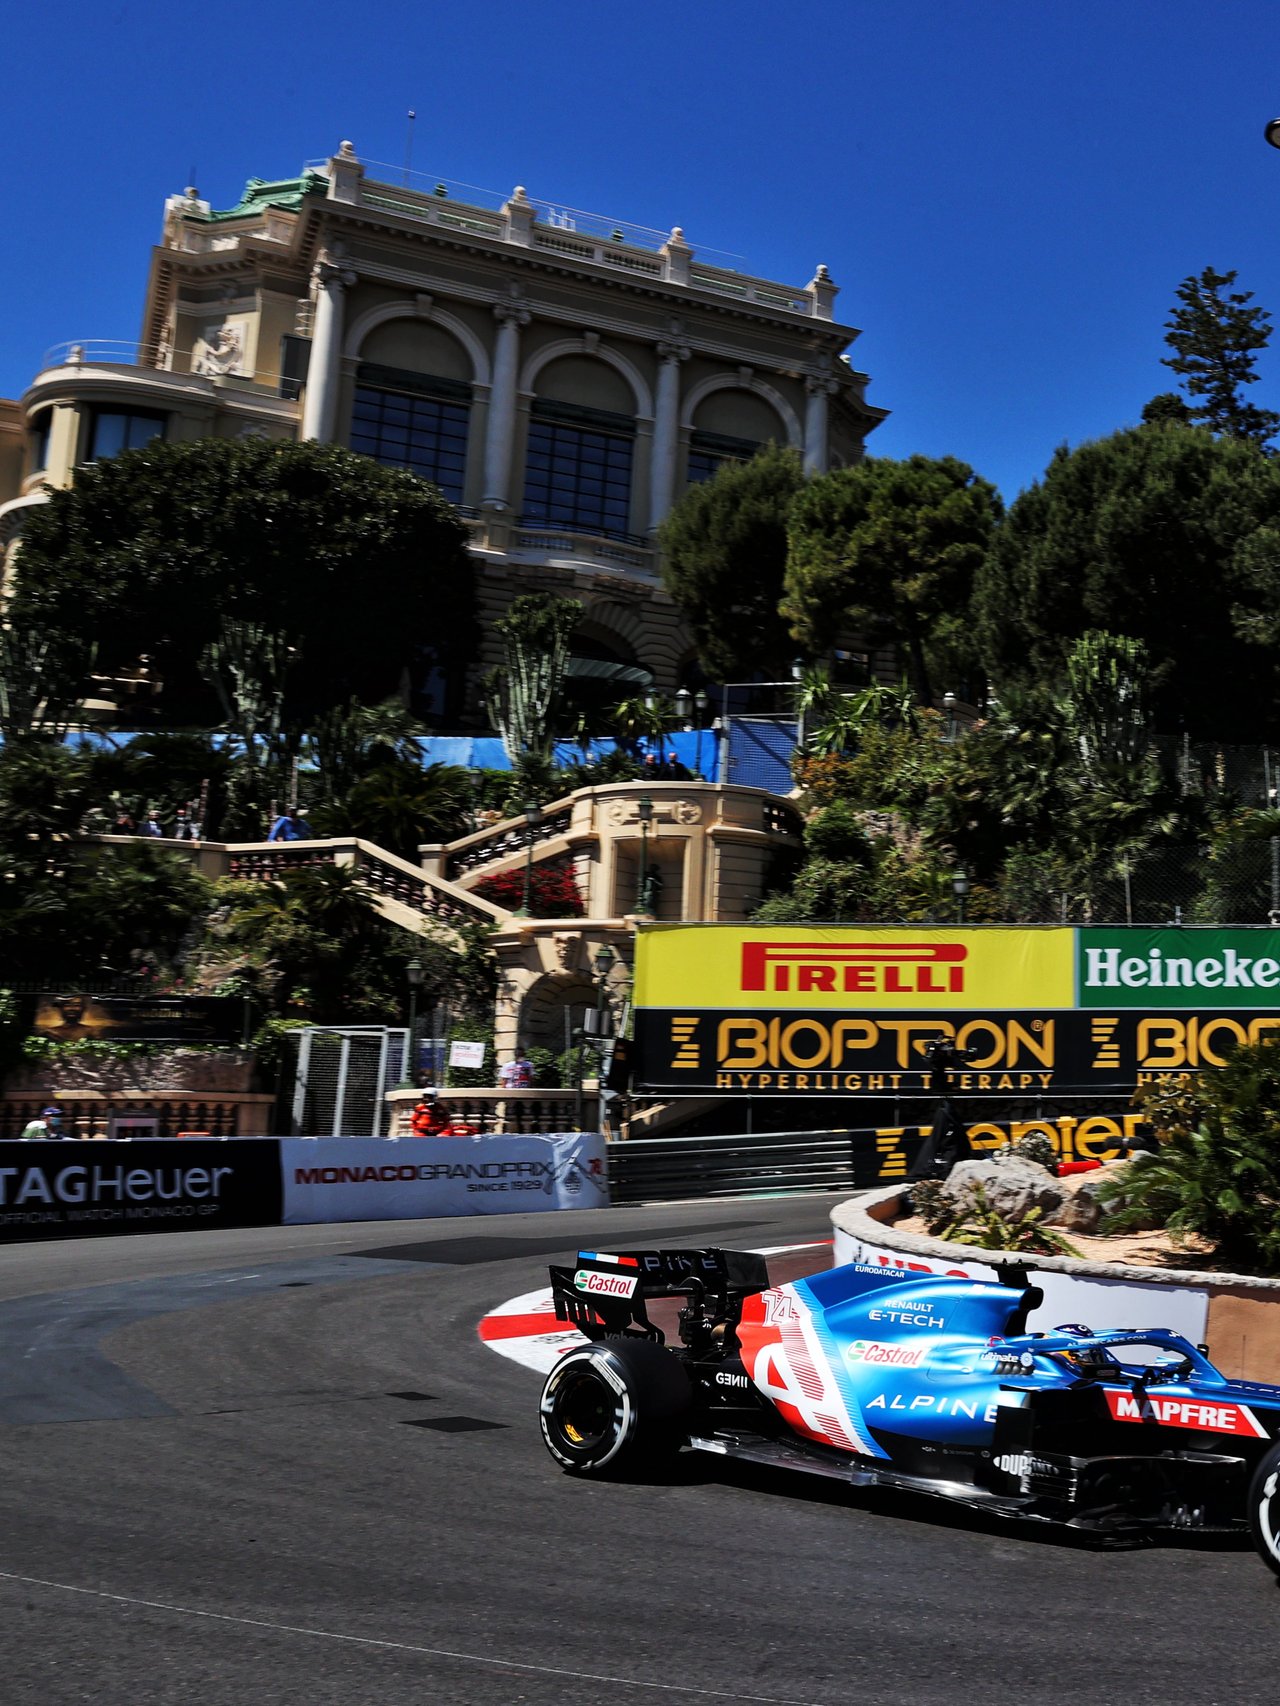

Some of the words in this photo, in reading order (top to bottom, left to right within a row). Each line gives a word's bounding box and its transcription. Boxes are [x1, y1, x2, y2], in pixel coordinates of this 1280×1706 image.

[741, 941, 968, 992] PIRELLI
[716, 1073, 902, 1090] HYPERLIGHT
[467, 1182, 509, 1193] SINCE
[511, 1179, 543, 1191] 1929
[126, 1205, 195, 1219] MONACO
[854, 1265, 905, 1279] EURODATACAR
[588, 1274, 632, 1295] Castrol
[761, 1292, 794, 1327] 14
[884, 1299, 934, 1313] RENAULT
[868, 1309, 945, 1329] E-TECH
[863, 1344, 921, 1366] Castrol
[980, 1351, 1019, 1363] ultimate
[866, 1393, 998, 1424] ALPINE
[1117, 1397, 1236, 1430] MAPFRE
